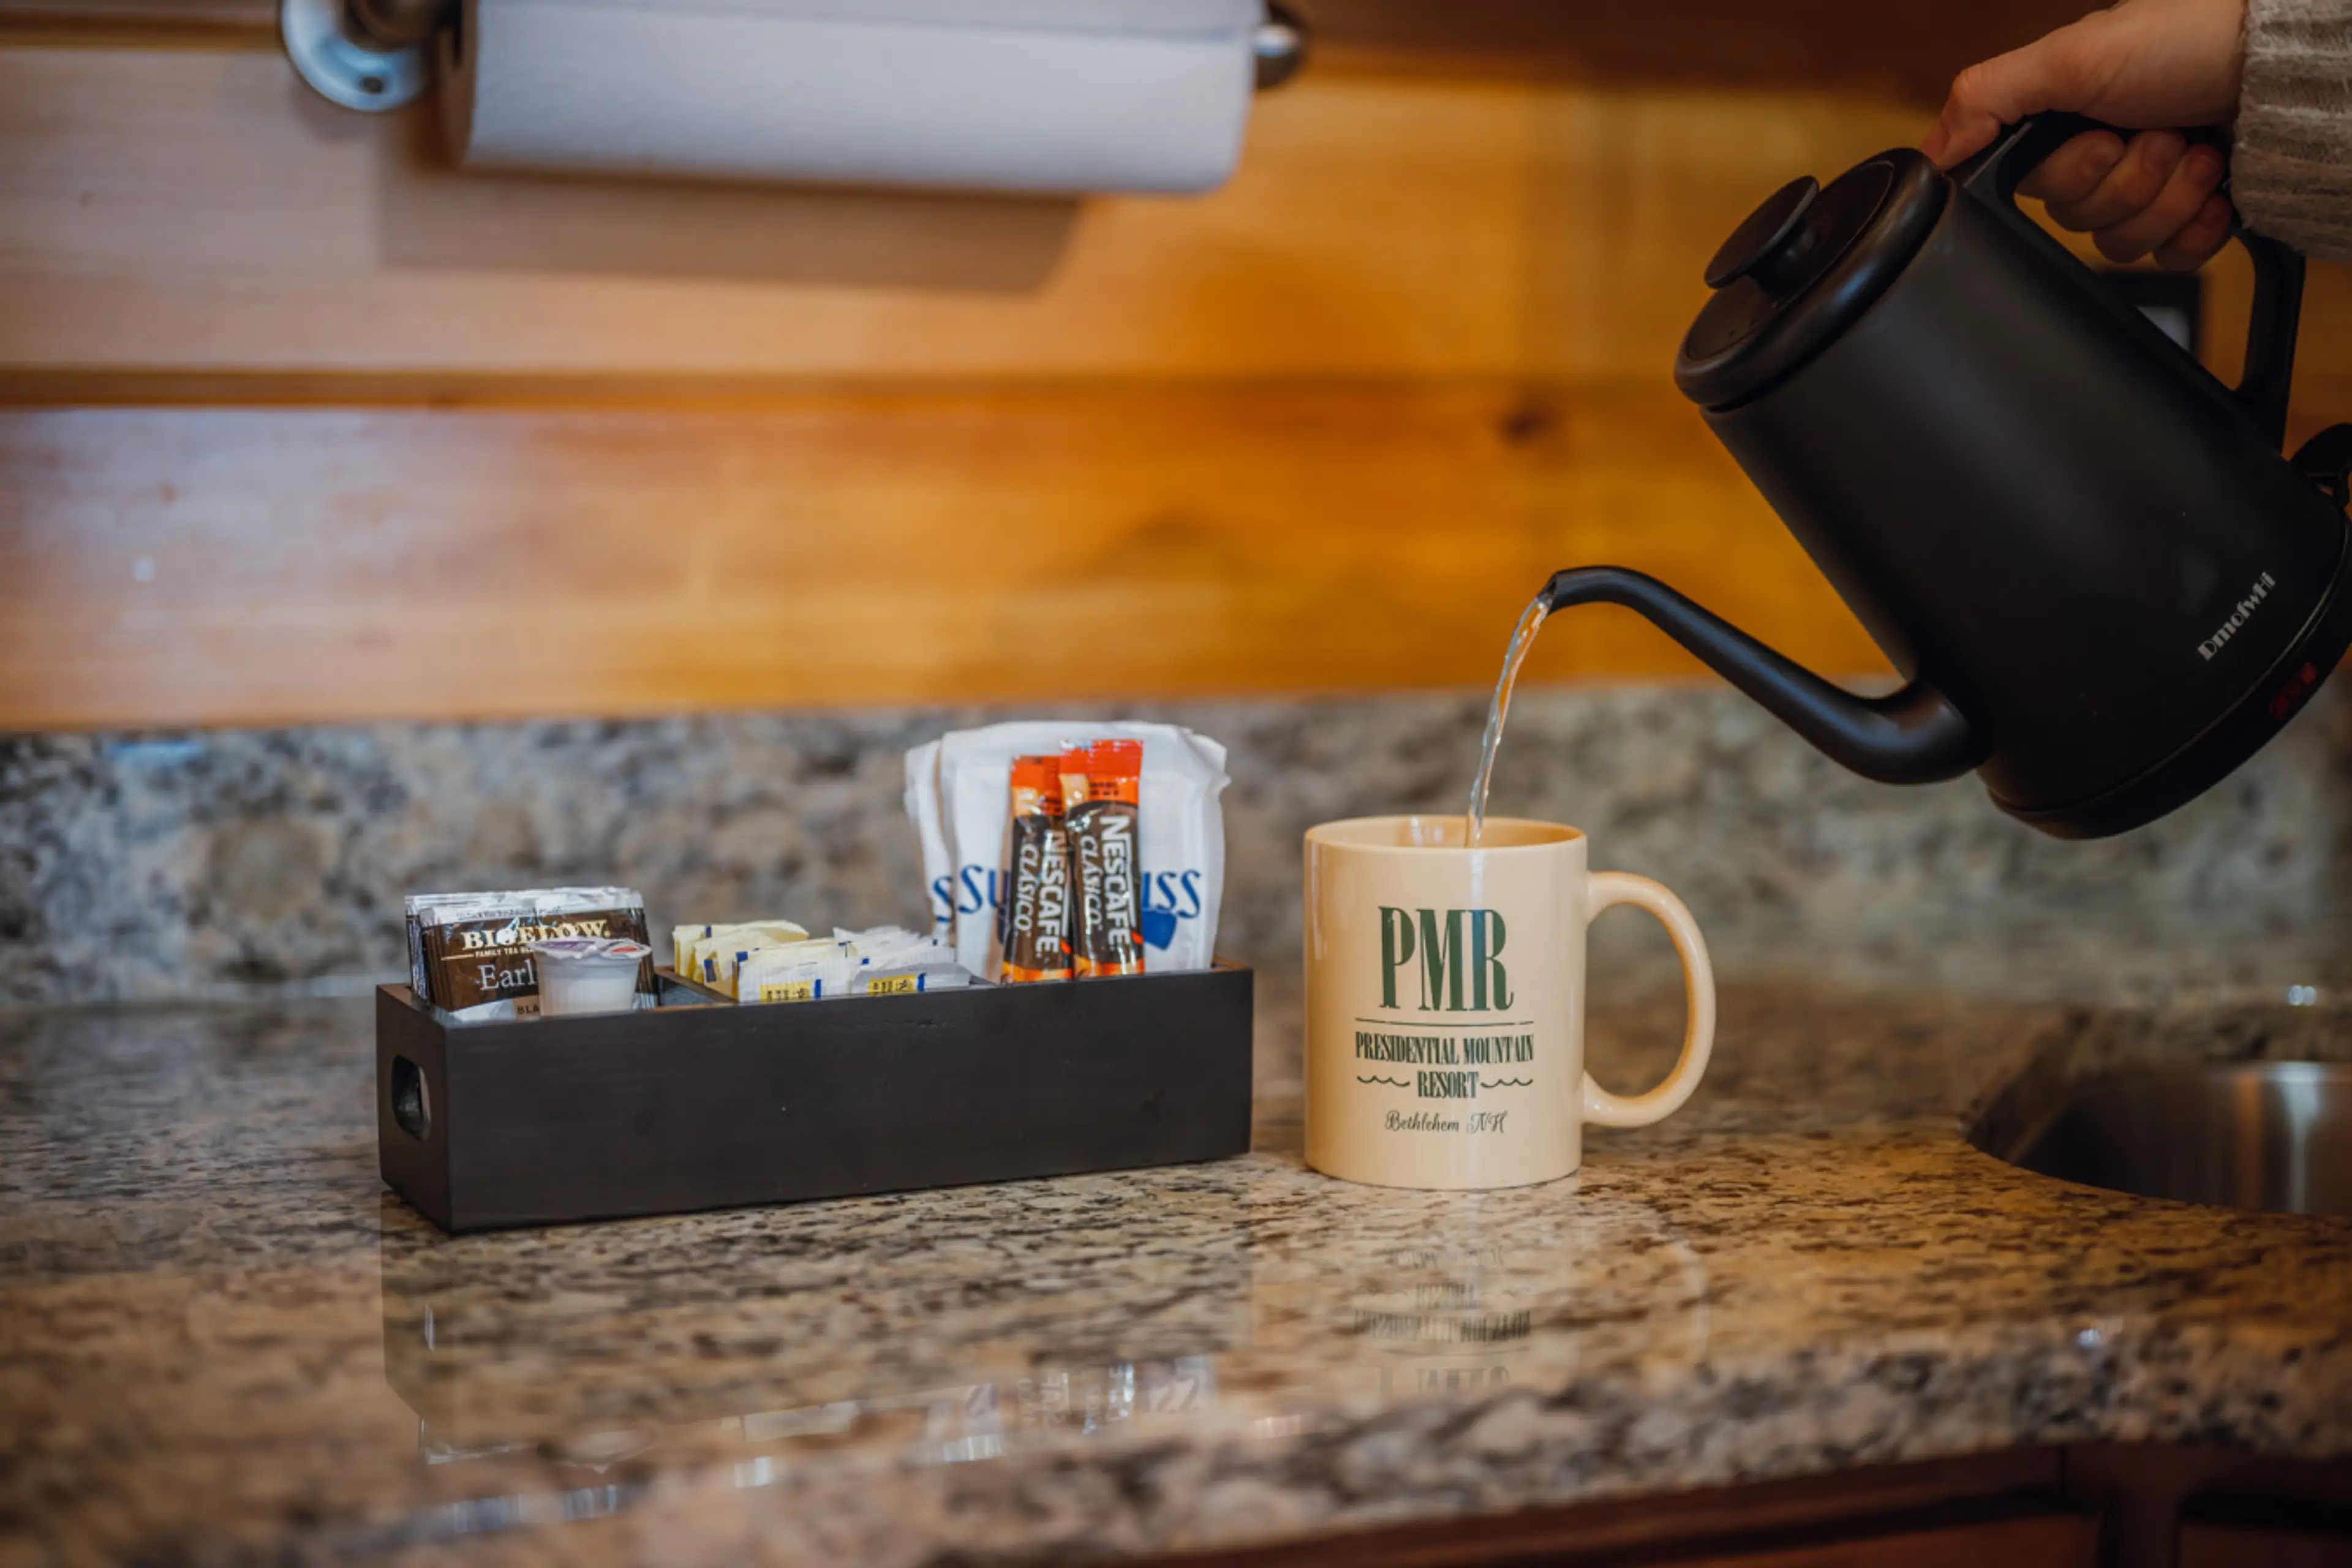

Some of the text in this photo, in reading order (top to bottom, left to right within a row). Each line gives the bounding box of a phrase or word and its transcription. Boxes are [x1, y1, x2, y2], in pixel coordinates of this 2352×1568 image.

[1378, 906, 1514, 1011] PMR
[477, 959, 537, 990] Earl
[1355, 1031, 1534, 1065] PRESIDENTIAL MOUNTAIN
[1417, 1070, 1479, 1099] RESORT
[1384, 1109, 1460, 1132] Bethlehem
